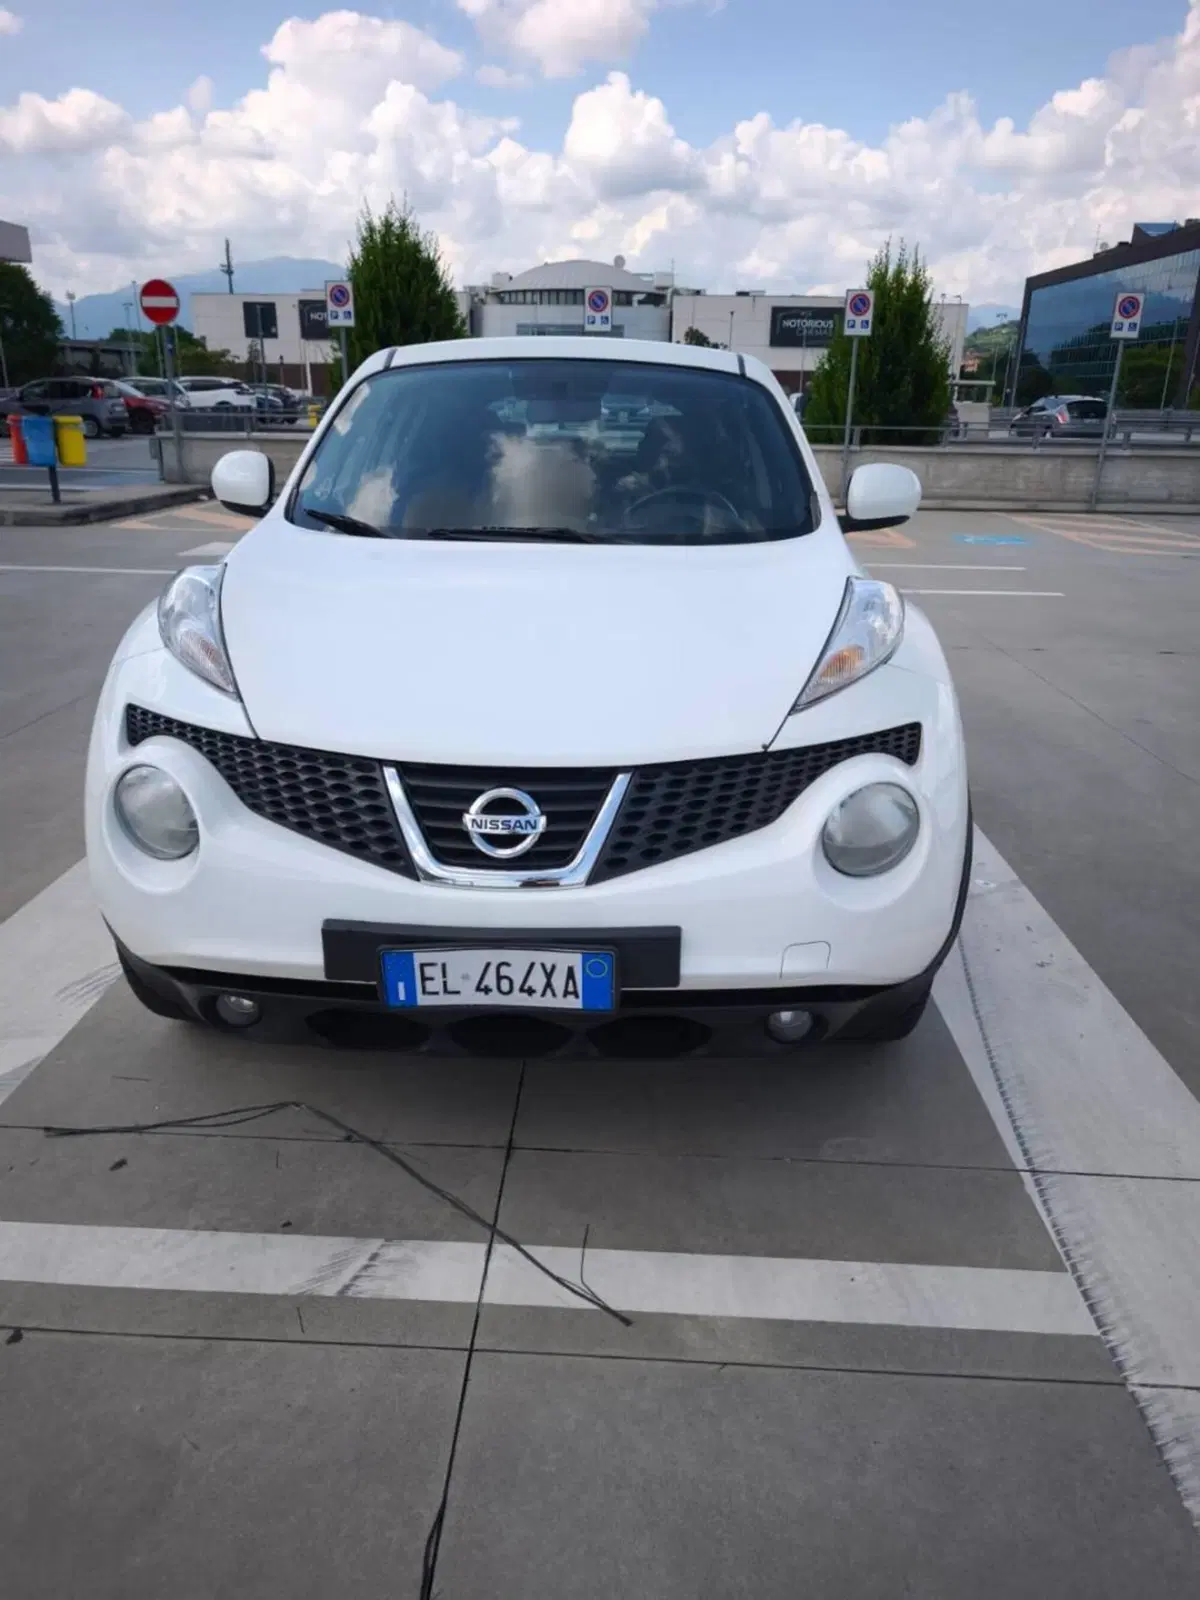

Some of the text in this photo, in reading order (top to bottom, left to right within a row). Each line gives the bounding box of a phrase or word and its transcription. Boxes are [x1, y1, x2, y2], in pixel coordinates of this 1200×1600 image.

[782, 319, 833, 328] NOTORIOUS
[471, 819, 537, 830] NISSAN
[419, 961, 580, 999] EL 464XA
